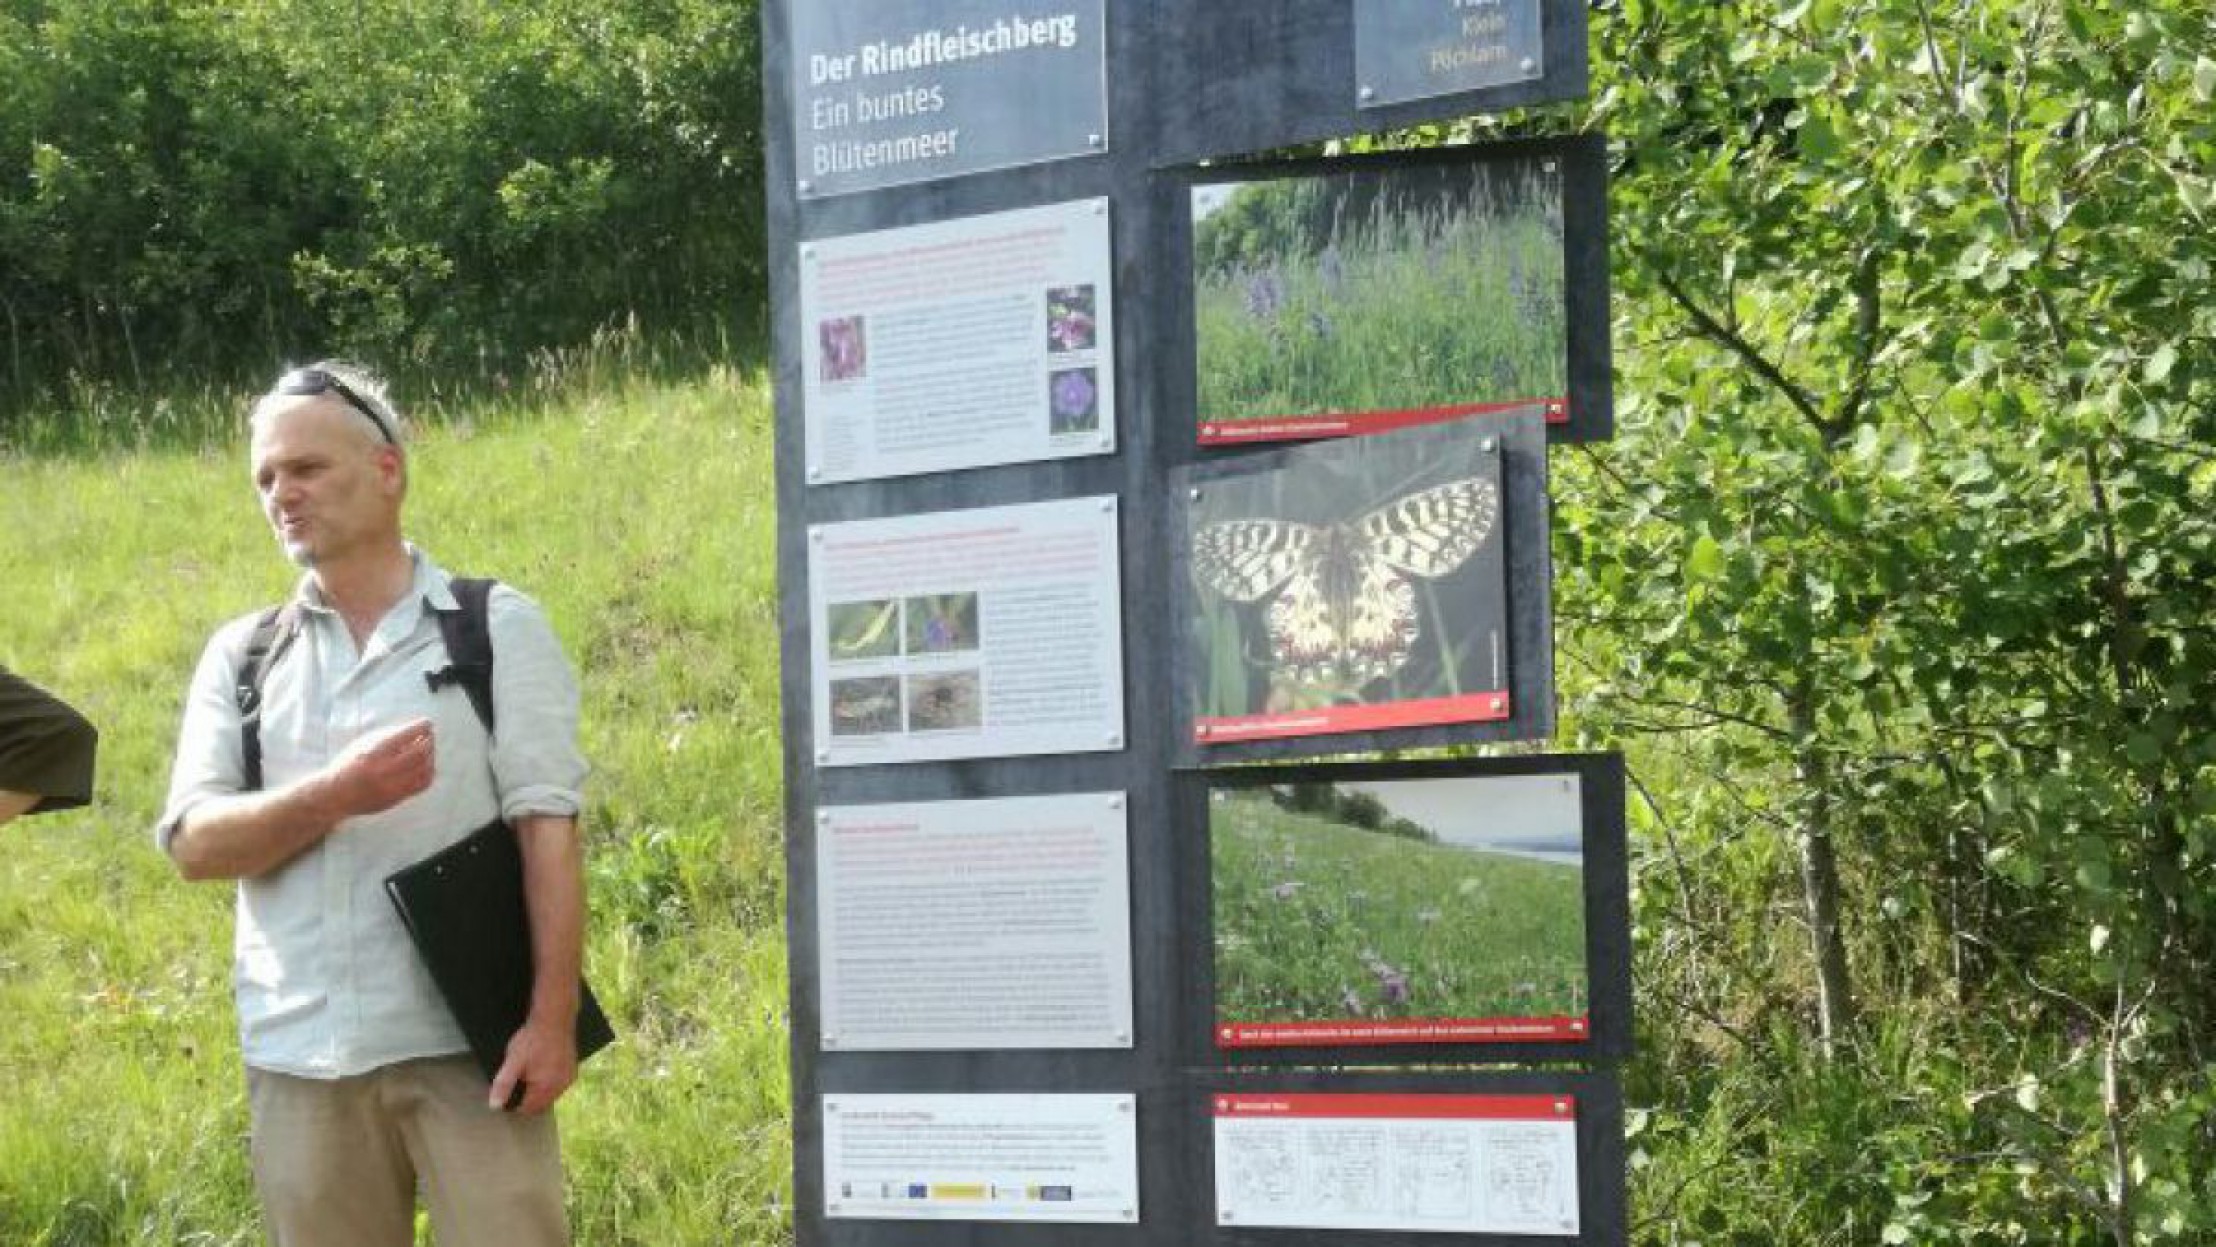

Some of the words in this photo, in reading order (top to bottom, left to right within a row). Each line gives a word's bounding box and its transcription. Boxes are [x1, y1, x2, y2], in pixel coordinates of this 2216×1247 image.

[809, 53, 856, 85] Der
[861, 14, 1077, 76] Rindfleischberg
[812, 98, 849, 130] Ein
[857, 84, 945, 122] buntes
[813, 126, 959, 176] Blütenmeer
